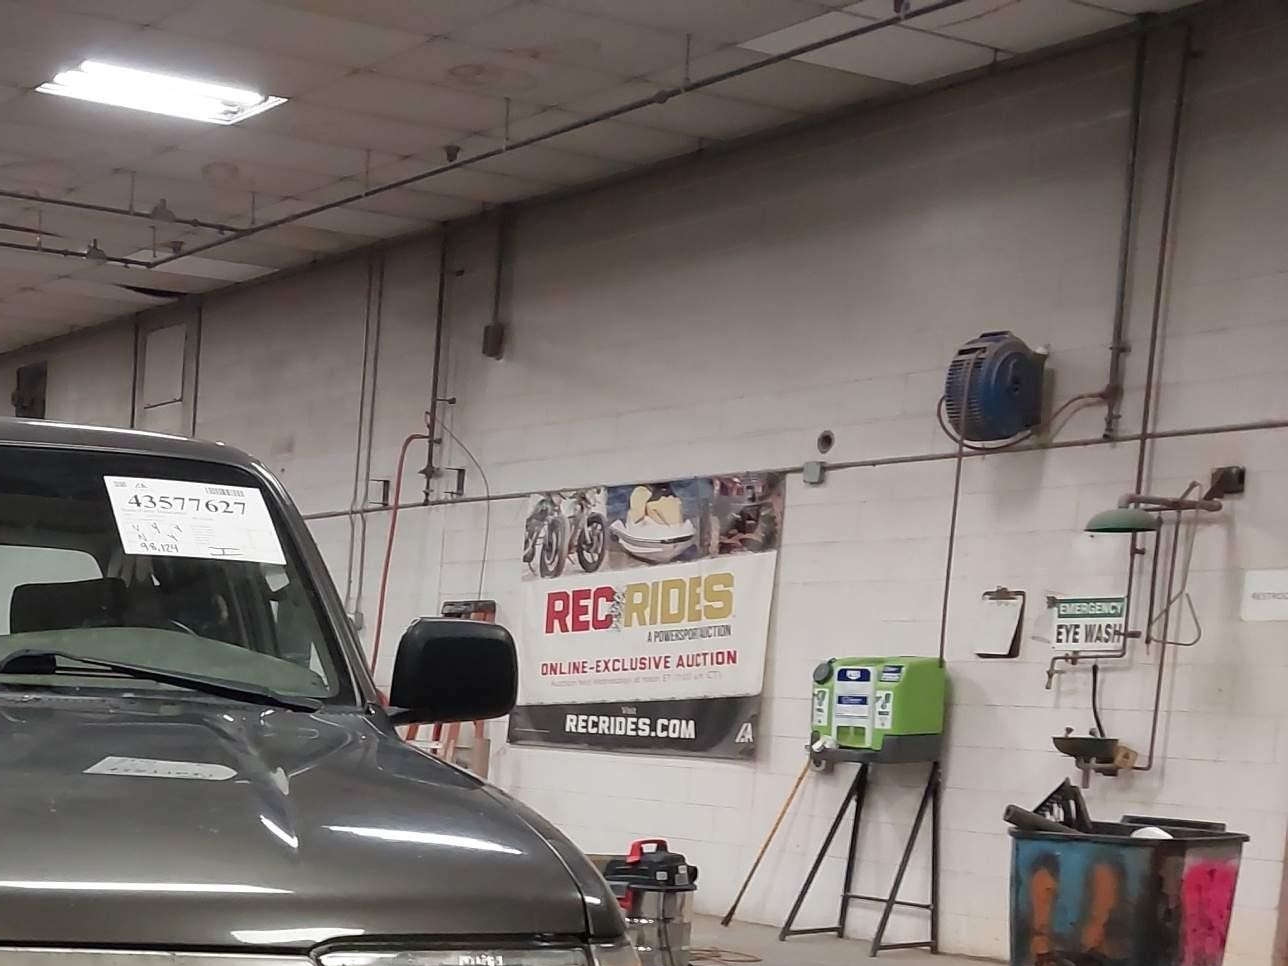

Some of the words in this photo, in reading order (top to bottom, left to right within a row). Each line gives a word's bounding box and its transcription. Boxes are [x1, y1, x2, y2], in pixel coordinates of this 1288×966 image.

[127, 494, 246, 516] 43577627
[1059, 602, 1124, 615] EMERGENCY
[1056, 623, 1081, 644] EYE
[1084, 623, 1123, 644] WASH
[541, 655, 671, 676] ONLINE-EXCLUSIVE
[676, 650, 737, 669] AUCTION
[565, 714, 696, 739] RECRIDES.COM
